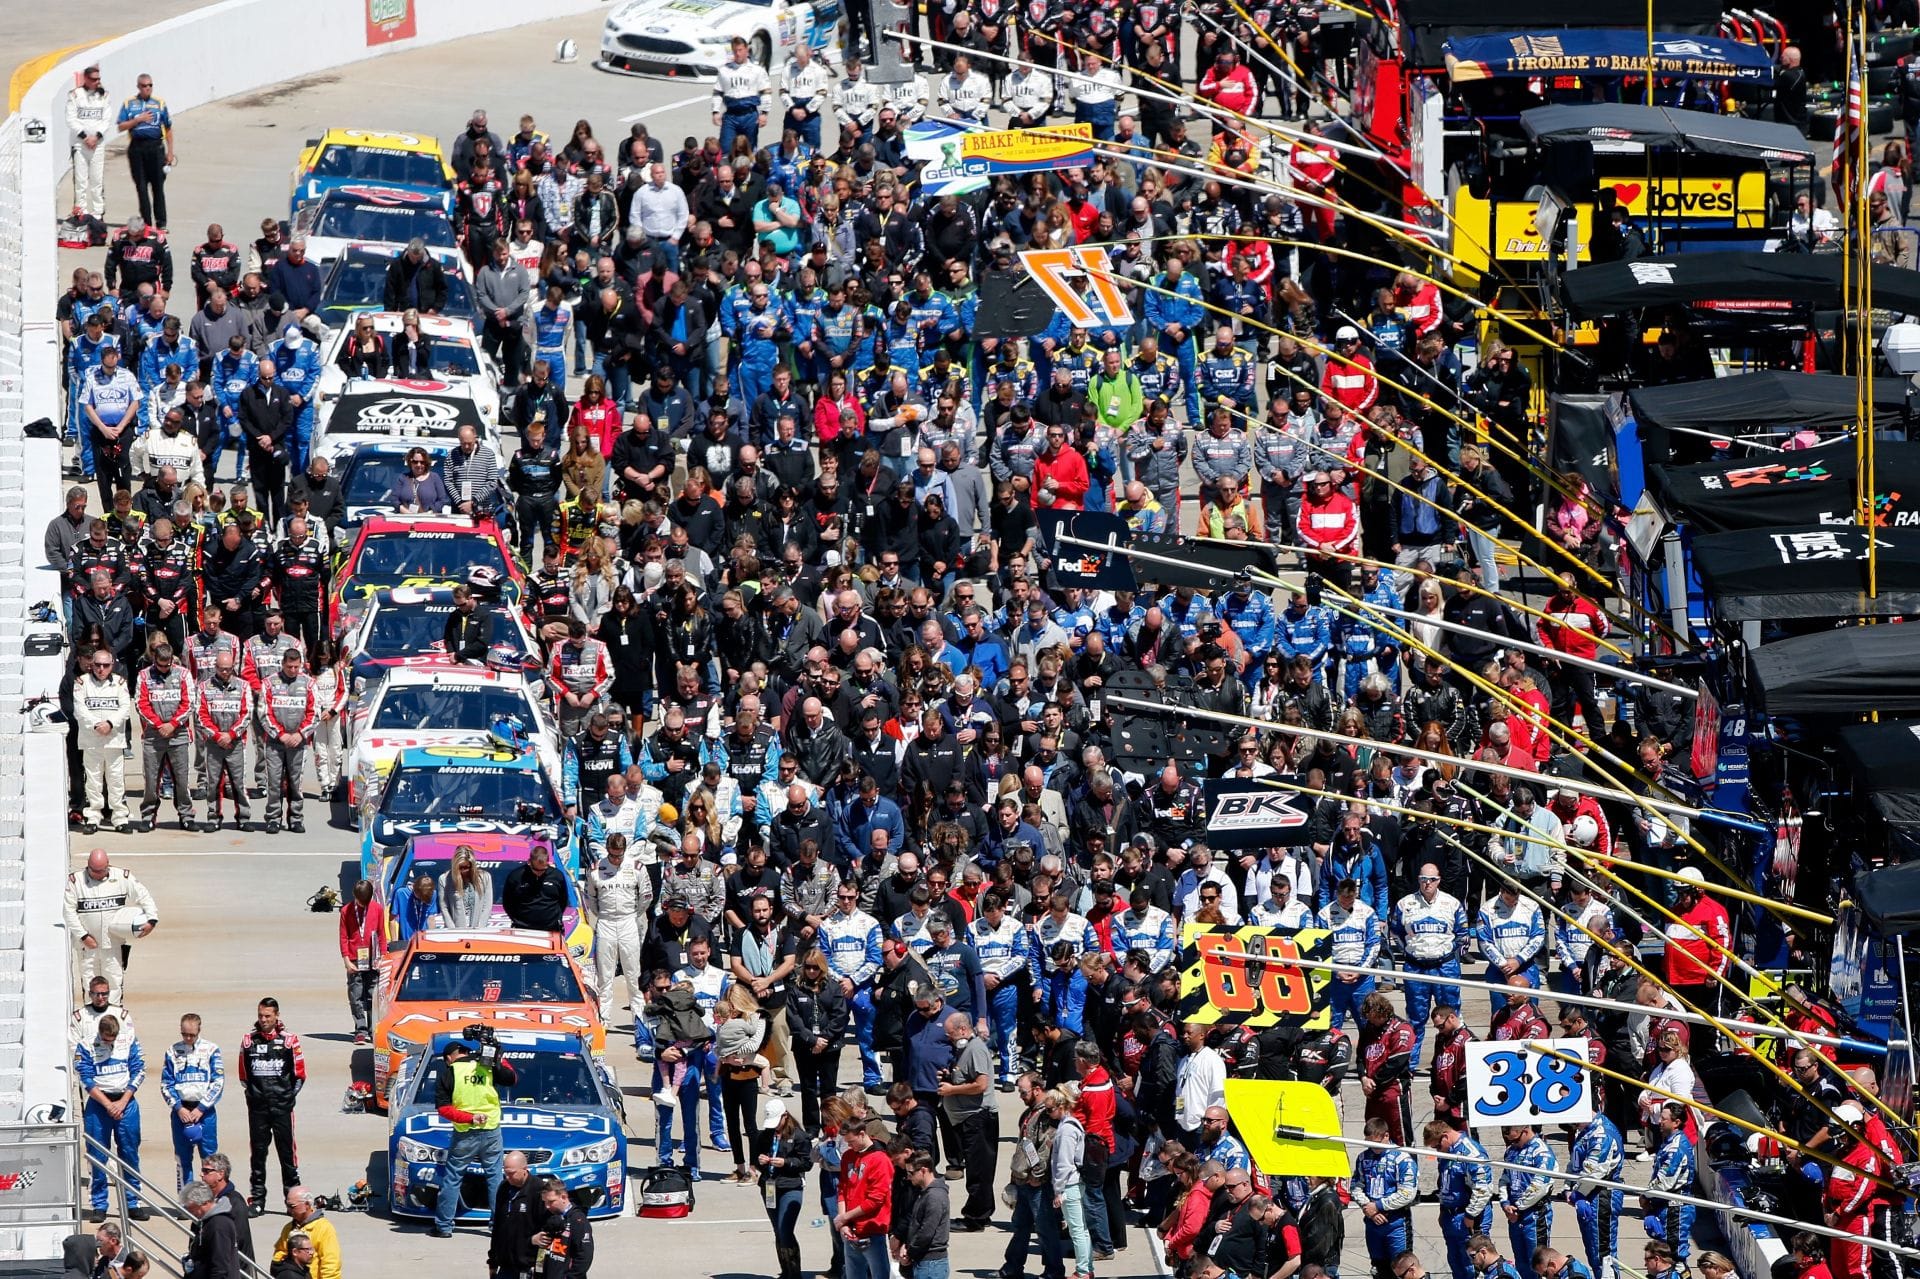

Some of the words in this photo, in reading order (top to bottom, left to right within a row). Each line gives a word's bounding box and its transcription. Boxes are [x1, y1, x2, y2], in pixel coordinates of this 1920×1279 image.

[1518, 56, 1590, 70] PROMISE
[1595, 57, 1608, 68] TO
[1661, 59, 1683, 72] FOR
[1686, 58, 1737, 76] TRAINS
[972, 134, 1014, 151] BRAKE
[359, 416, 456, 430] ADVOCARE
[156, 457, 190, 468] OFFICIAL
[1894, 511, 1920, 527] RA
[1058, 560, 1100, 574] FedEx
[431, 684, 482, 693] PATRICK
[150, 690, 181, 702] TaxAct
[208, 702, 240, 714] TaxAct
[272, 696, 306, 709] TaxAct
[1724, 720, 1746, 737] 48
[438, 766, 505, 775] McDOWELL
[1219, 795, 1300, 815] BK
[1154, 807, 1185, 818] FedEx
[1212, 816, 1281, 826] Racing
[601, 882, 632, 890] ARRIS
[83, 900, 118, 910] OFFICIAL
[1413, 922, 1448, 933] LOWE'S
[1498, 926, 1529, 938] LOWE'S
[1333, 932, 1364, 943] LOWE'S
[459, 954, 521, 963] EDWARDS
[1196, 933, 1312, 1014] 88
[483, 987, 500, 1001] 19
[393, 1010, 592, 1028] ARRIS
[96, 1063, 128, 1076] LOWE'S
[464, 1074, 485, 1086] FOX
[1475, 1048, 1584, 1117] 38
[417, 1167, 435, 1182] 48
